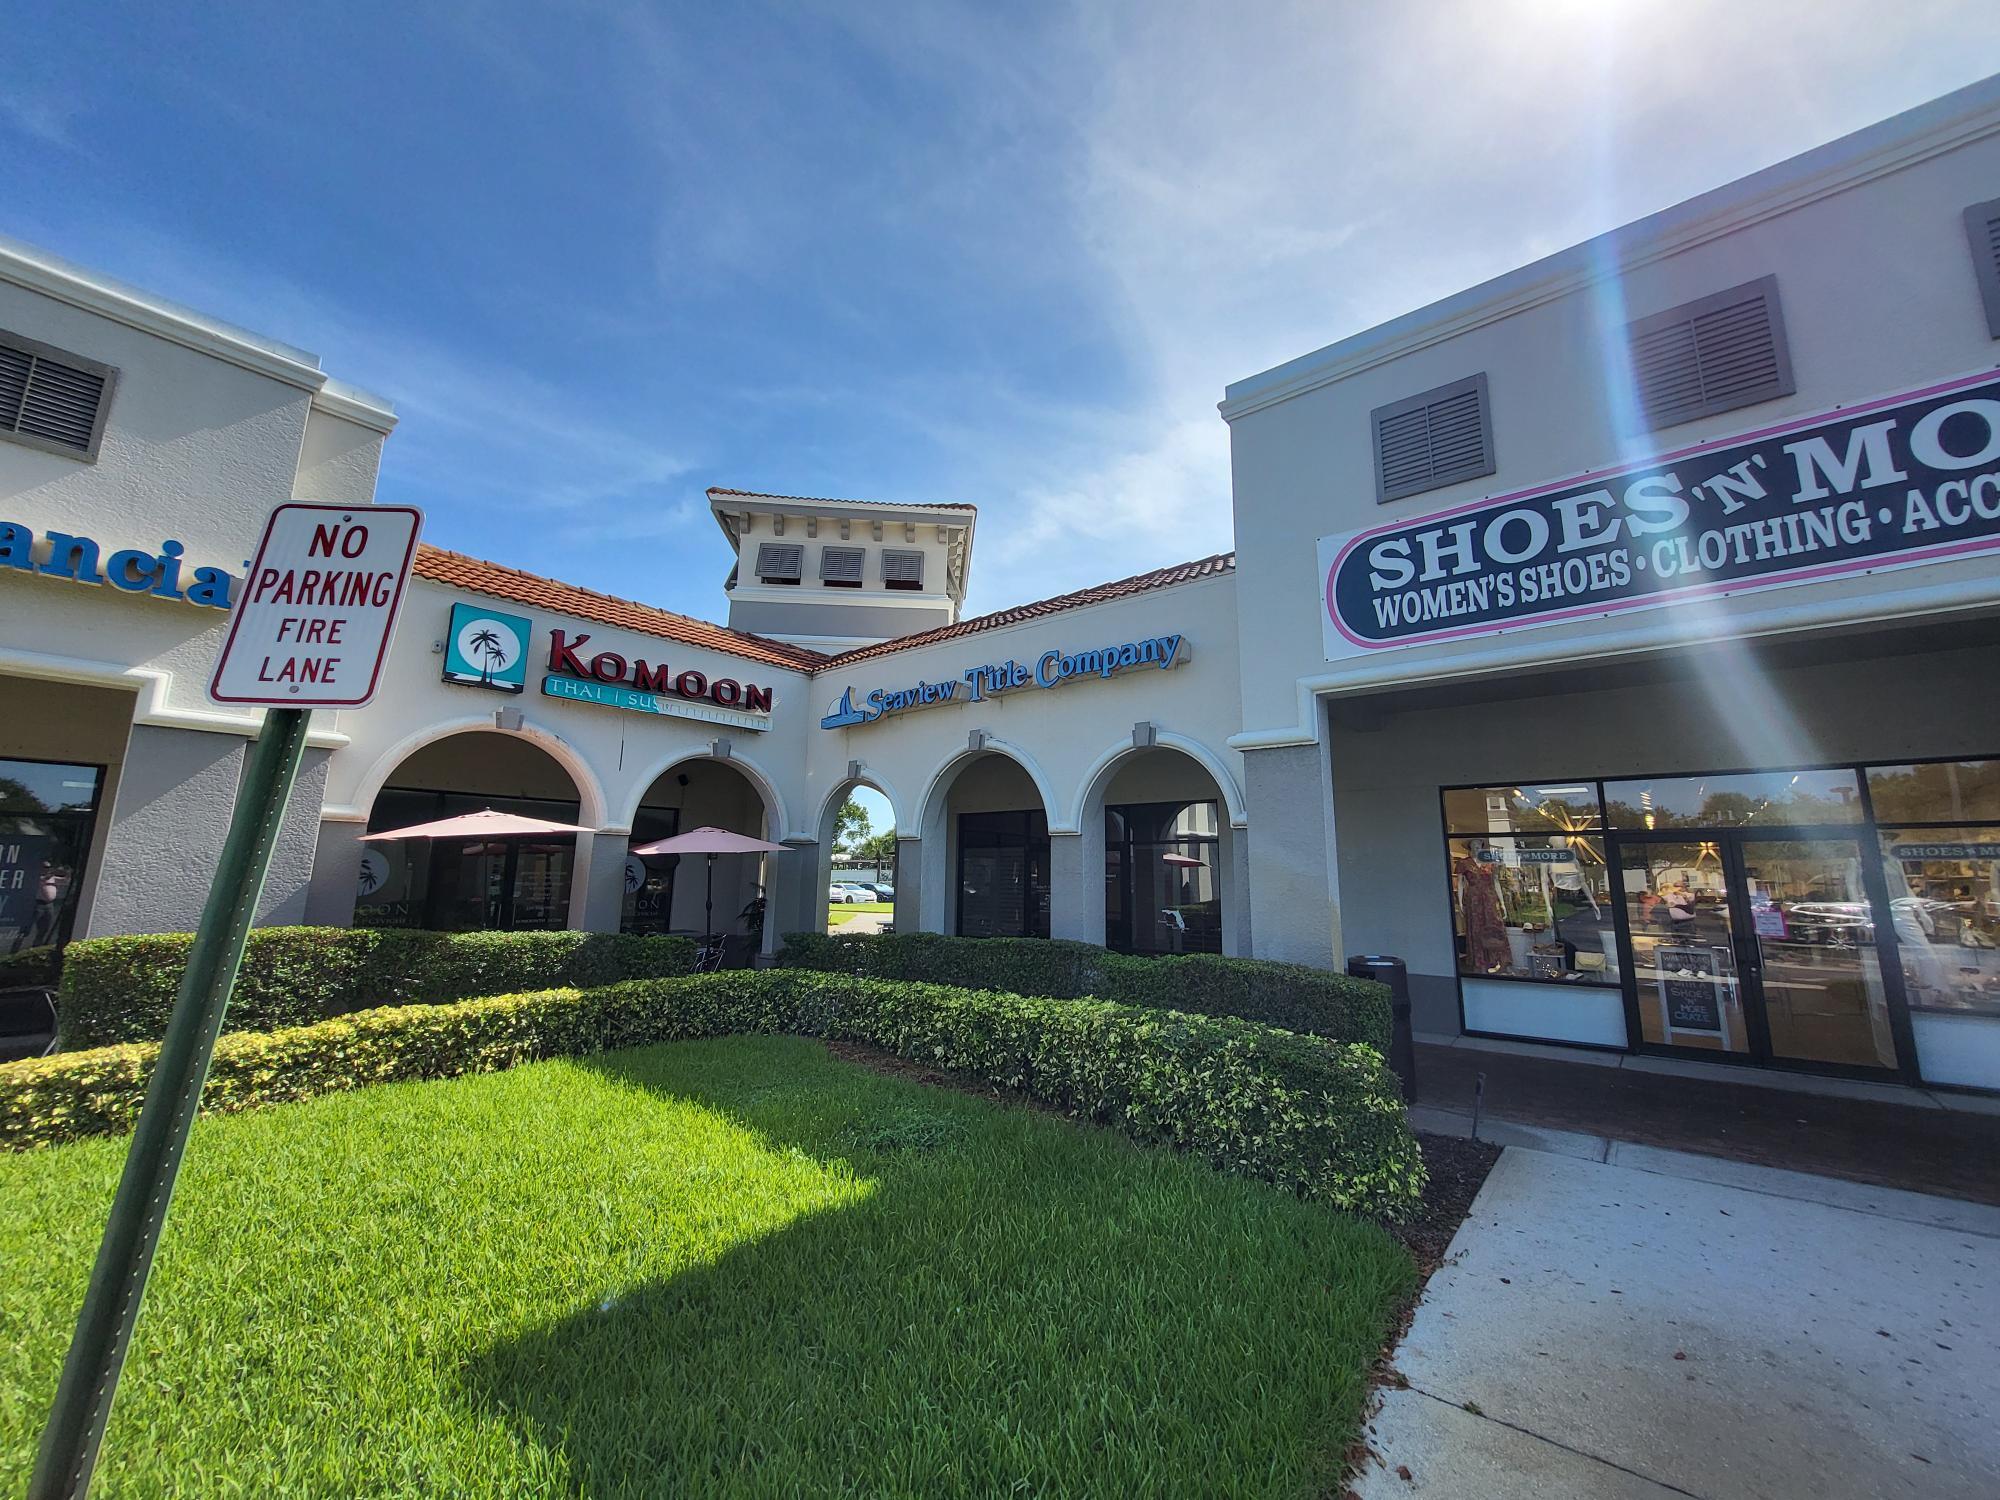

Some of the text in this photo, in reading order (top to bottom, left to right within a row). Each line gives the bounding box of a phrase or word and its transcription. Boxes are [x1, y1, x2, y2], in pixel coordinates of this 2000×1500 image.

[309, 524, 369, 558] NO
[1368, 473, 1692, 590] SHOES
[1373, 574, 1516, 628] WOMEN'S
[1520, 548, 1632, 604] SHOES
[1651, 501, 1871, 579] CLOTHING
[254, 568, 394, 608] PARKING
[277, 618, 347, 644] FIRE
[258, 656, 341, 683] LANE
[866, 634, 1181, 722] Seaview Title Company
[551, 679, 602, 699] THAI
[1531, 852, 1567, 860] MORE
[1899, 847, 1964, 857] SHOES
